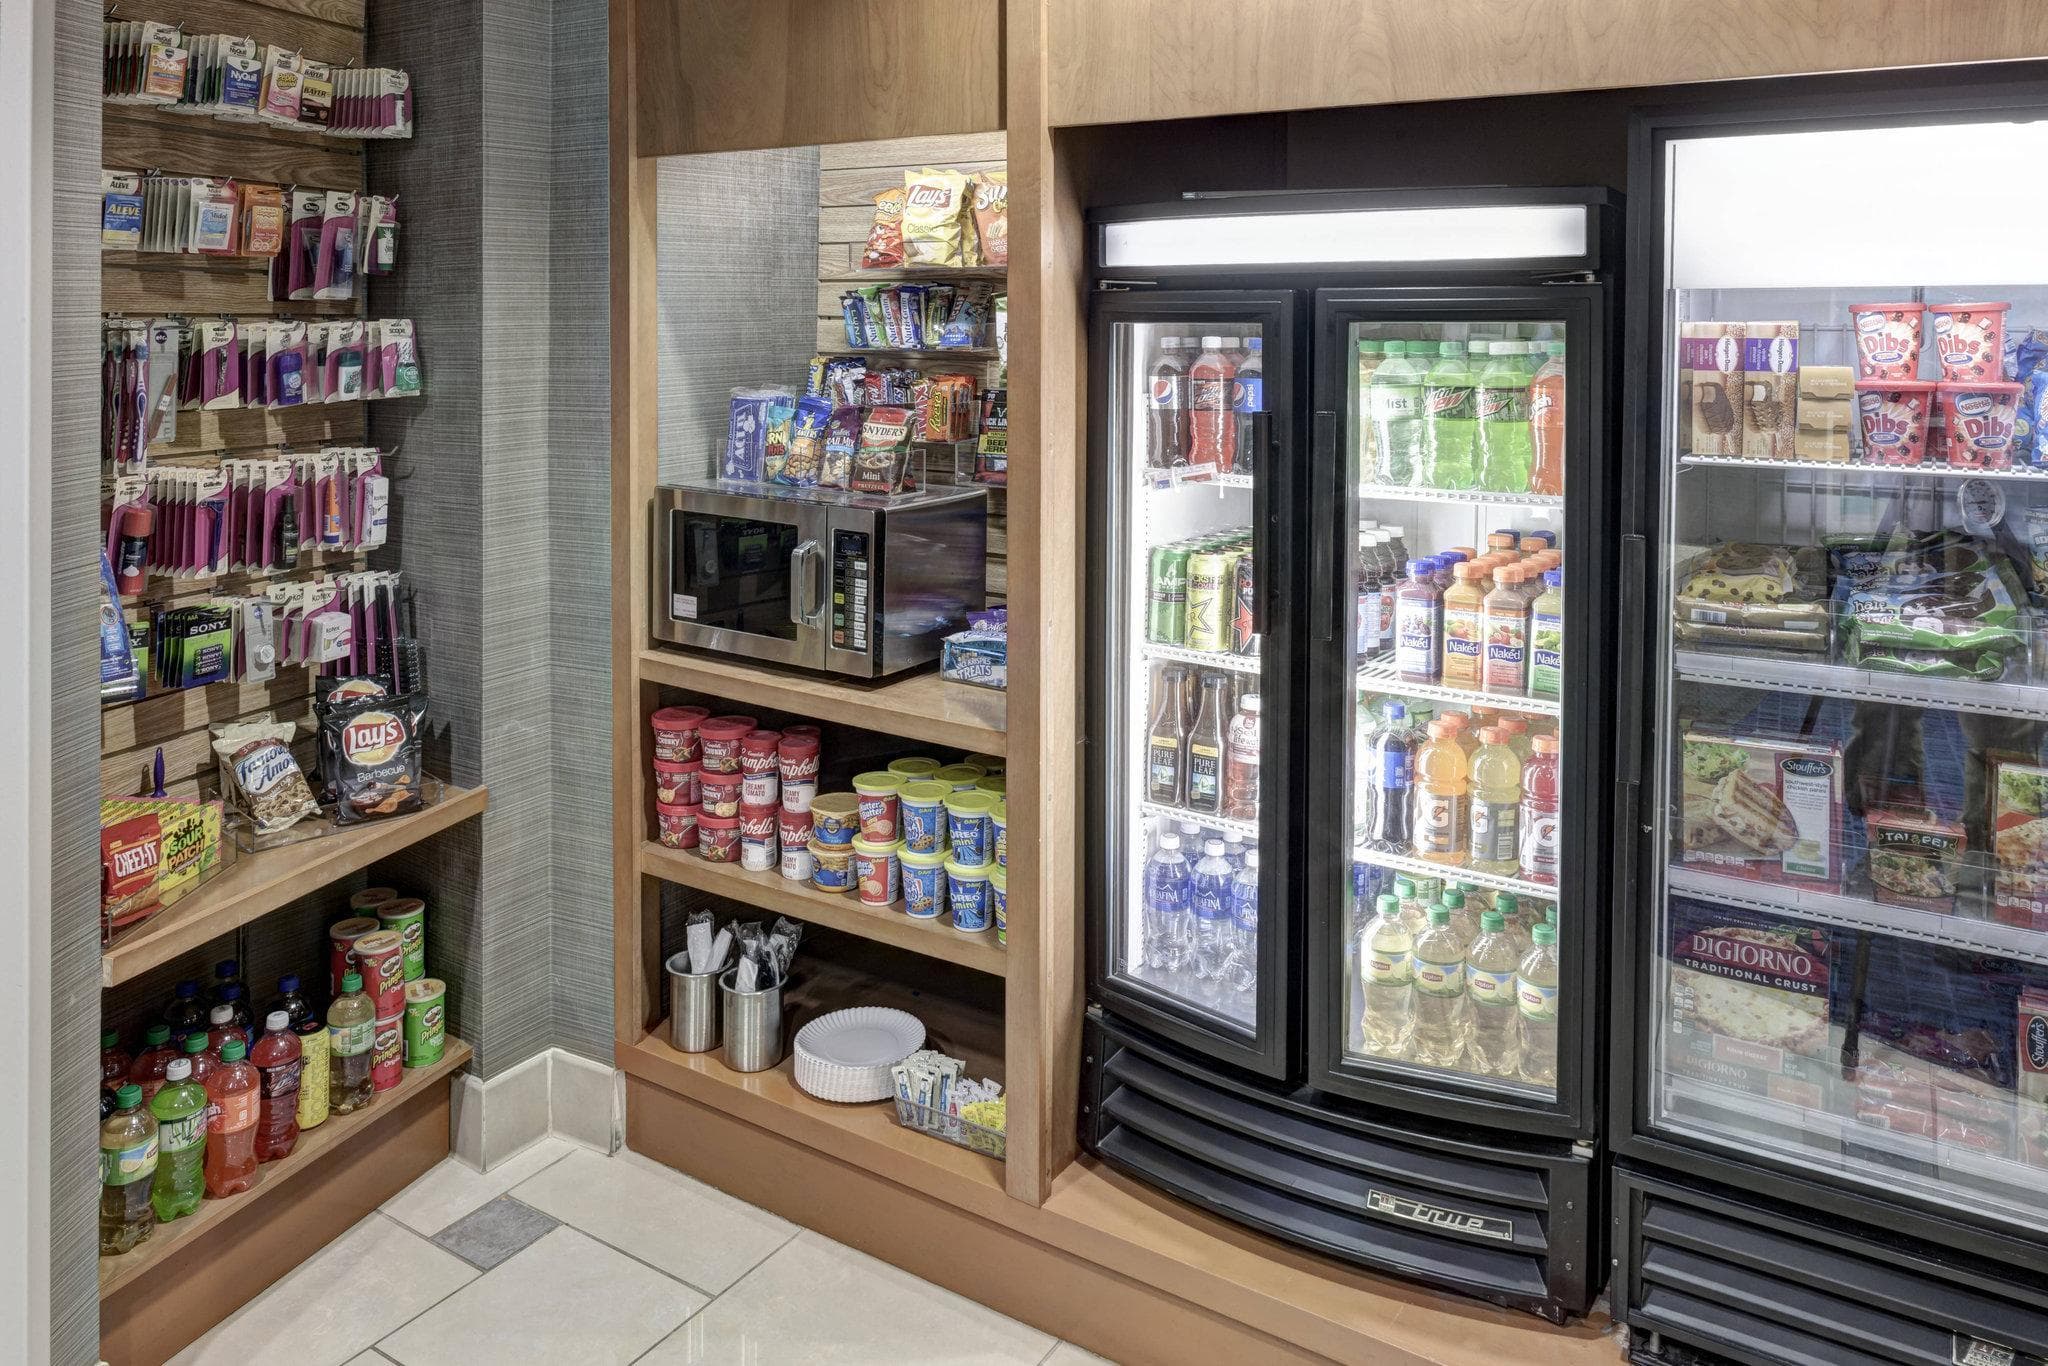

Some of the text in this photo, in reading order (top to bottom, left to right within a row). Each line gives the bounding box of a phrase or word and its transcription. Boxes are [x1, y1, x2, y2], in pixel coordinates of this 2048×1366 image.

[152, 58, 182, 72] DayQuil
[230, 69, 258, 83] NyQuil
[304, 69, 324, 79] BAYER
[303, 86, 327, 97] BAYER
[109, 179, 130, 190] ALEVE
[106, 204, 142, 217] ALEVE
[304, 203, 320, 212] Dep
[334, 202, 349, 211] Dep
[907, 223, 936, 234] Classic
[1863, 331, 1910, 353] Dibs
[1938, 333, 1981, 354] Dibs
[1247, 383, 1255, 407] pepsi
[1864, 411, 1910, 435] Dibs
[1964, 415, 2013, 439] Dibs
[863, 424, 904, 437] SNYDER'S
[984, 445, 1007, 453] JERK
[862, 470, 880, 481] Mini
[1156, 577, 1186, 586] AMP
[1854, 600, 1887, 612] half
[189, 621, 226, 635] SONY
[1450, 641, 1480, 654] Naked
[1490, 647, 1521, 660] Naked
[957, 664, 993, 680] TREATS
[349, 721, 398, 755] Lay's
[1153, 749, 1174, 759] PURE
[1194, 757, 1216, 768] PURE
[1787, 760, 1826, 774] Stouffer's
[356, 764, 406, 783] Barbecue
[950, 829, 978, 839] OREO
[169, 826, 204, 856] SOUR
[114, 841, 157, 878] CHEEZ-IT
[169, 838, 205, 869] PATCH
[951, 893, 981, 902] OREO
[1423, 972, 1443, 982] Lipton
[1684, 958, 1818, 993] TRADITIONAL CRUST
[1475, 980, 1495, 990] Lipton
[1523, 991, 1541, 1004] Lipton
[2031, 1022, 2048, 1063] Stouffer's
